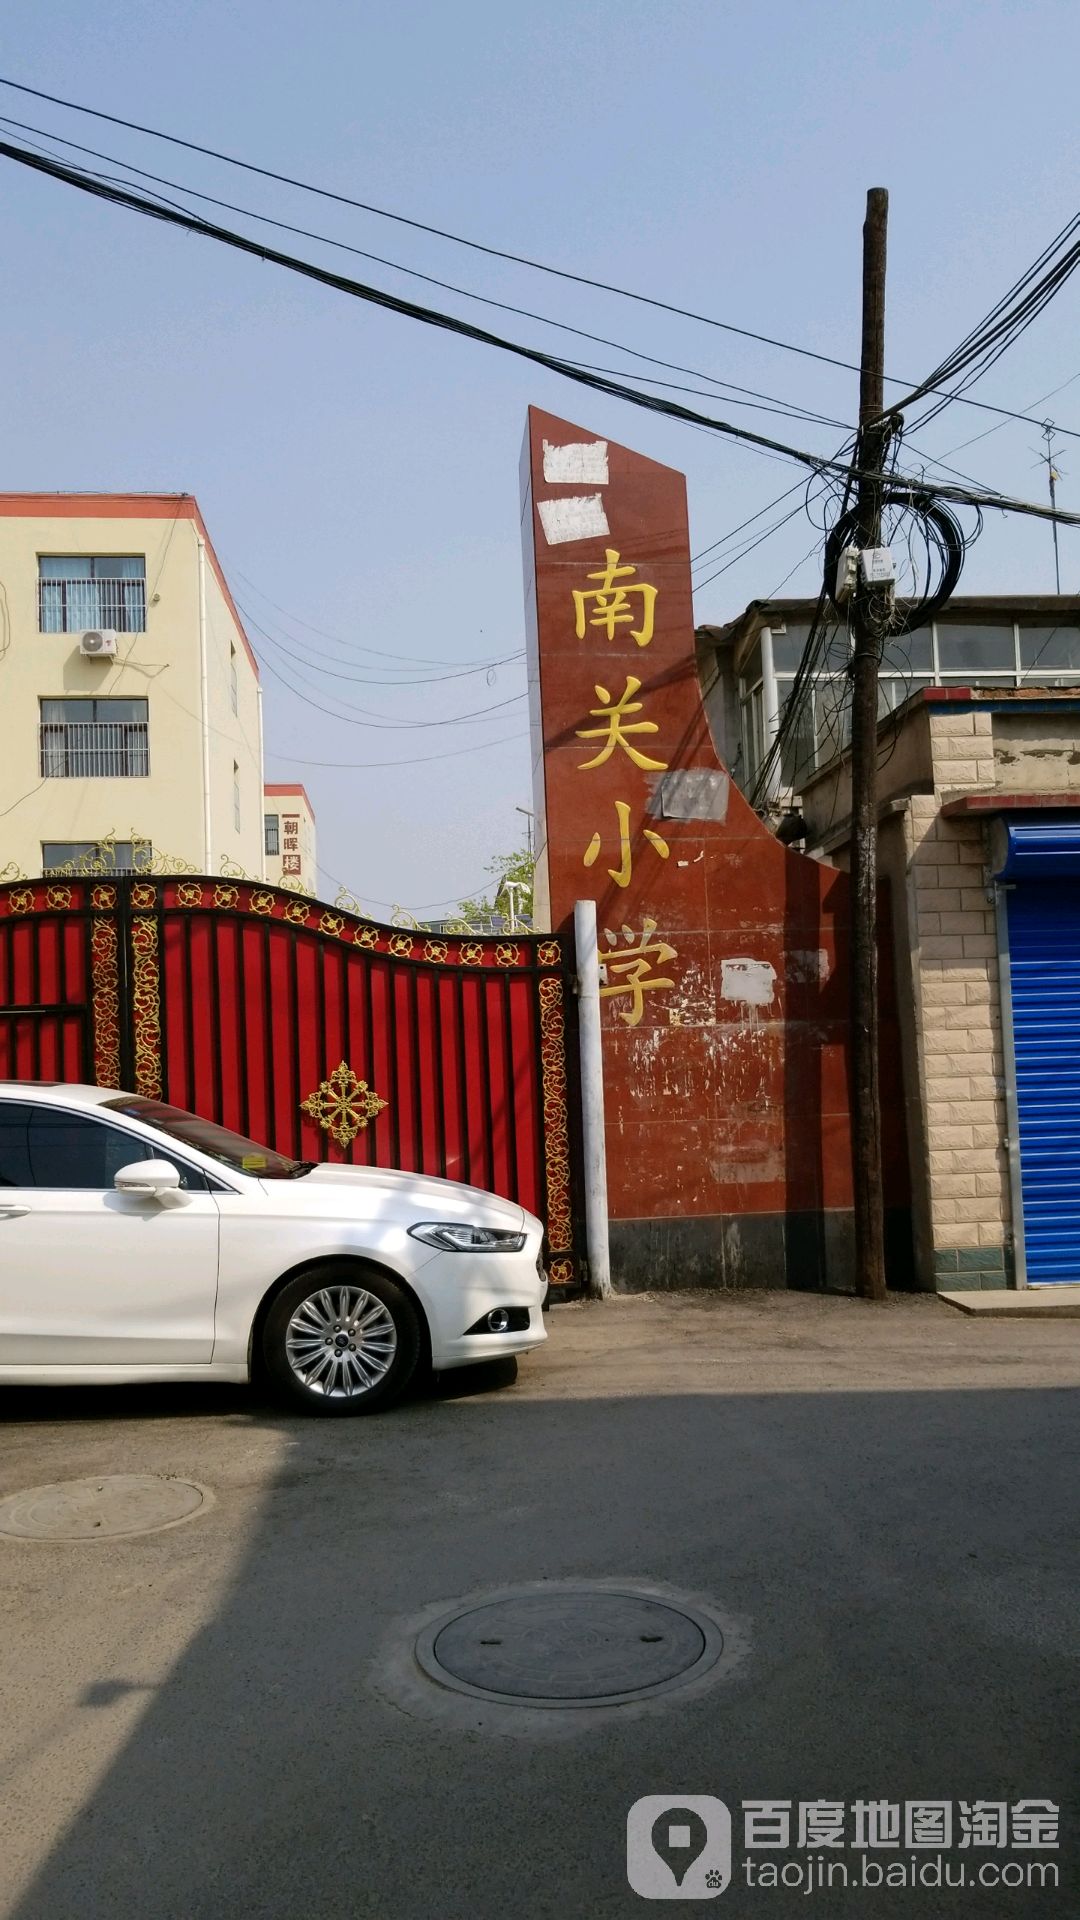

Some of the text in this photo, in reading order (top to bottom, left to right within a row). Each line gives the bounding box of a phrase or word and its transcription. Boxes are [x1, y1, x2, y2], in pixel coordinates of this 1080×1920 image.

[283, 821, 300, 871] 朝晖楼
[572, 549, 678, 1026] 南关小学
